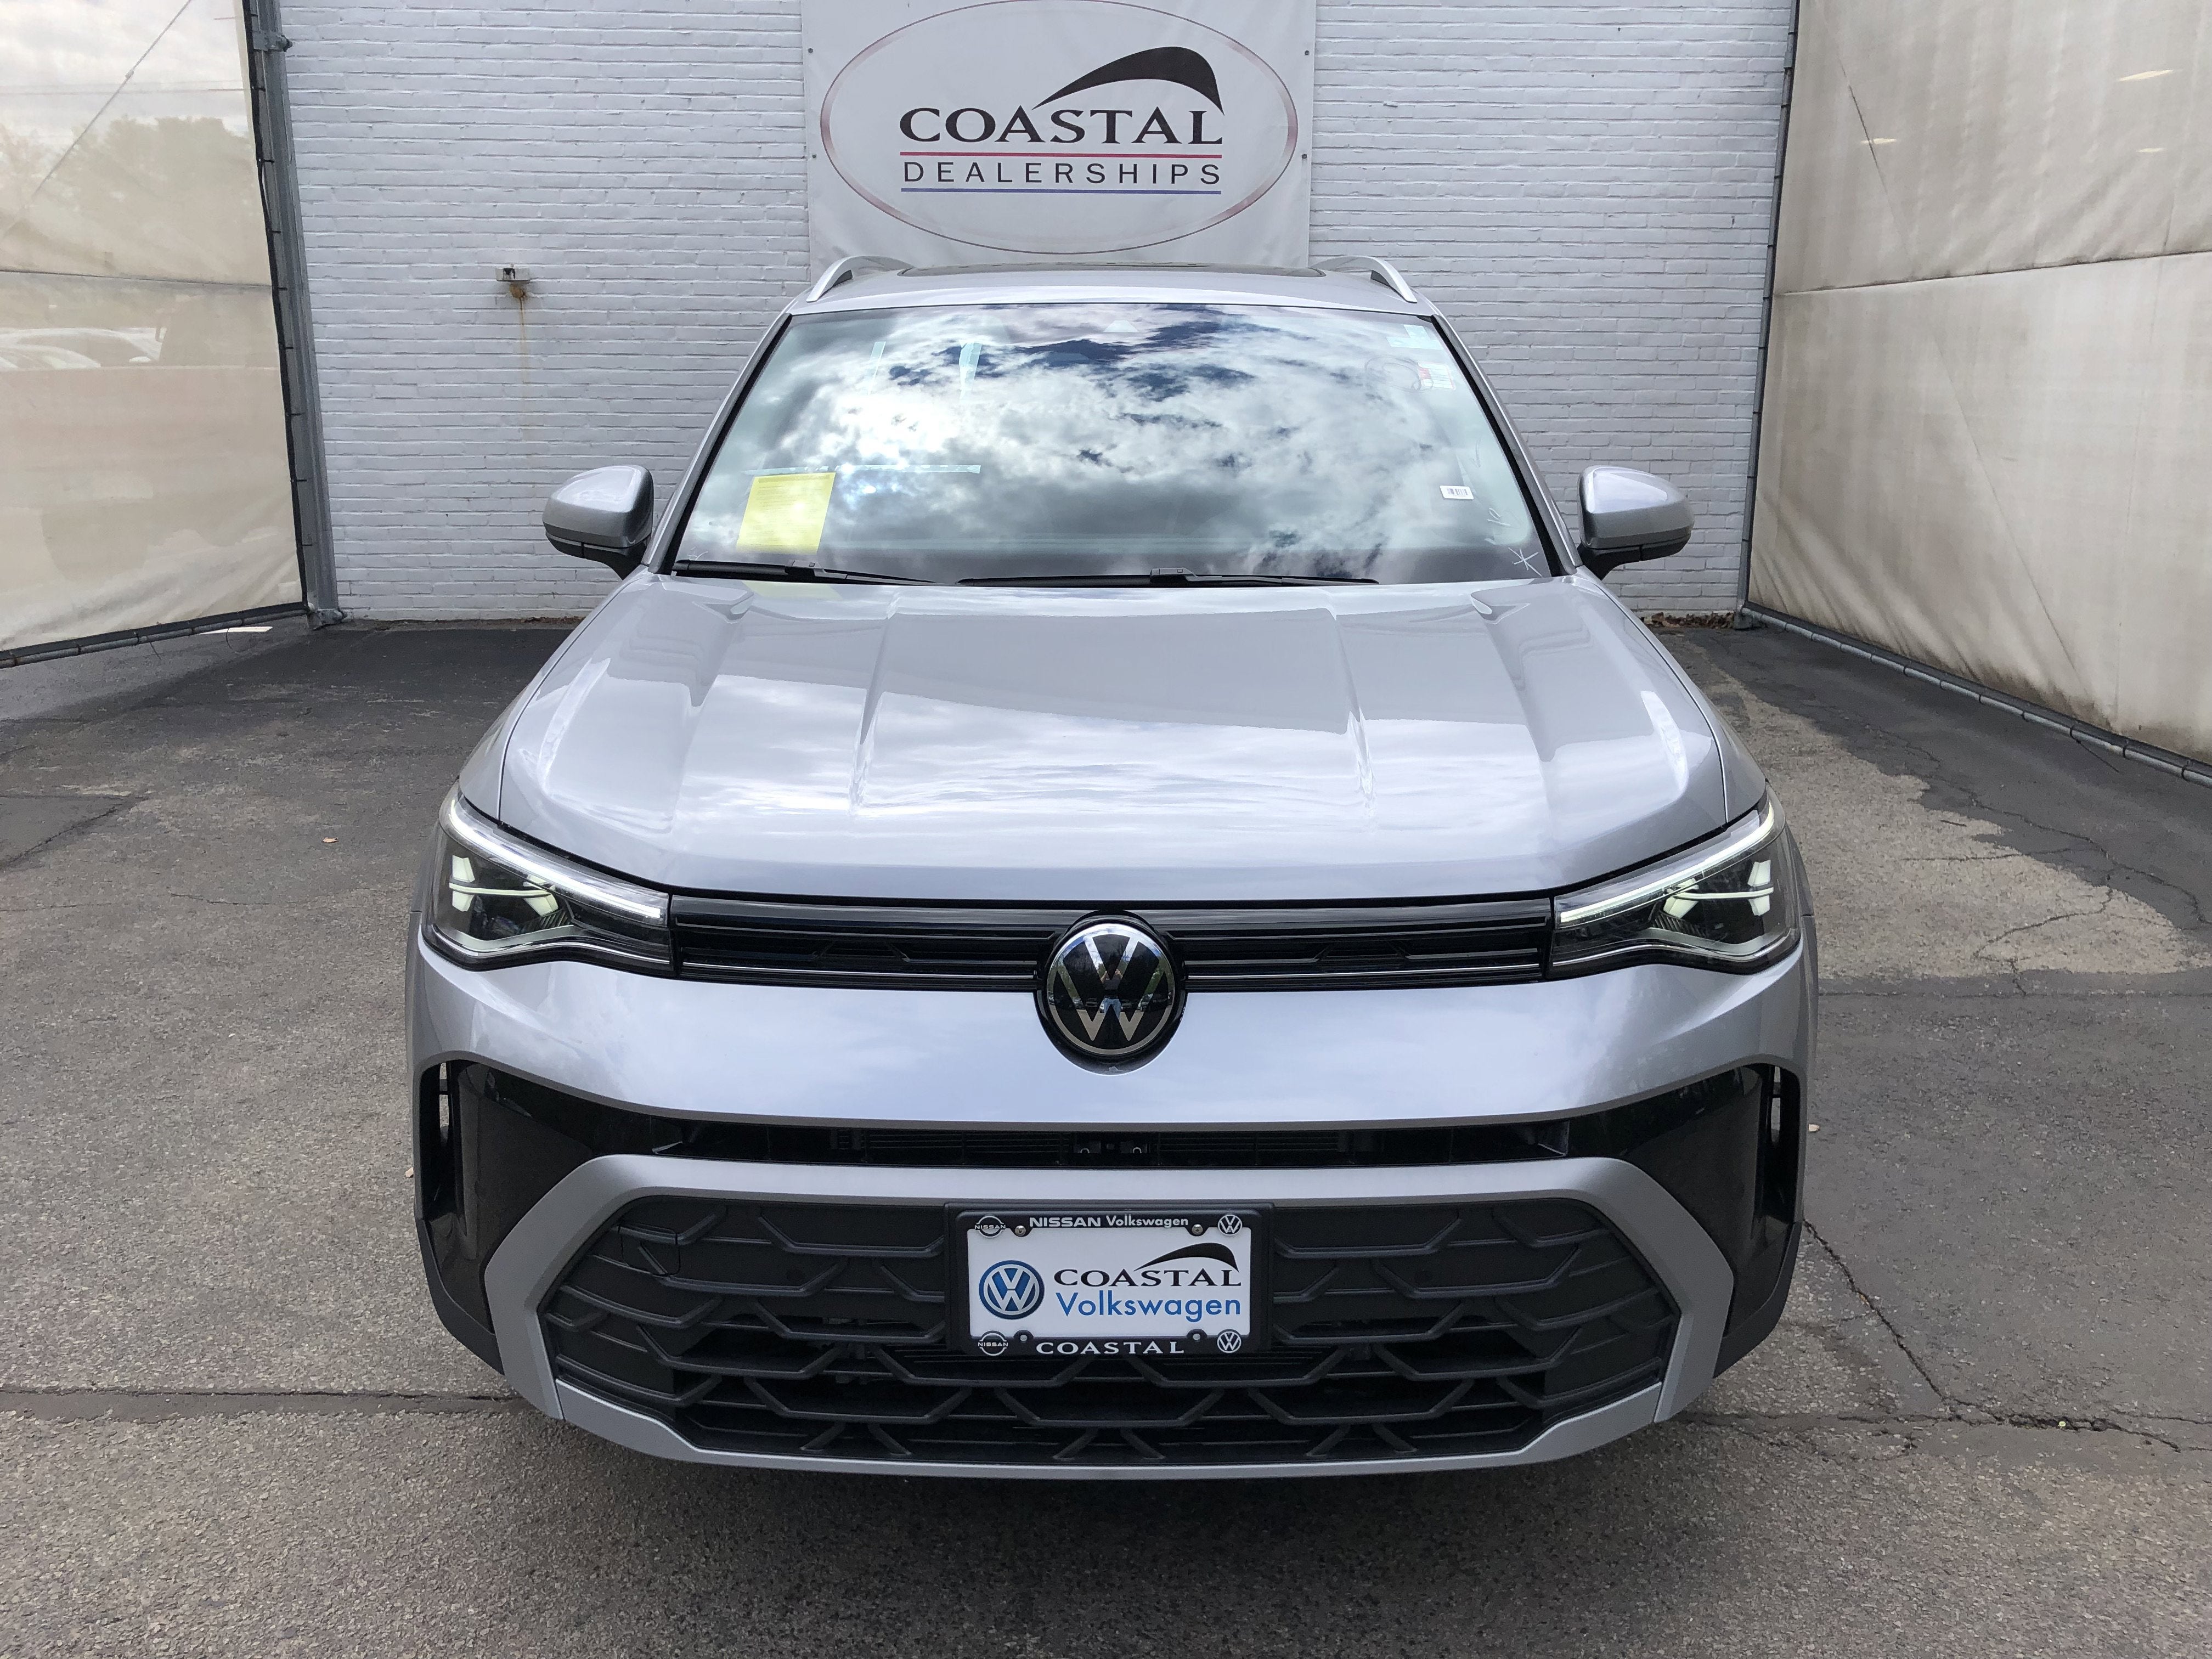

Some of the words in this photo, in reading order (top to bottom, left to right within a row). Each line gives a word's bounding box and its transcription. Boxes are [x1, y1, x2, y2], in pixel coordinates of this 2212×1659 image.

[899, 106, 1223, 145] COASTAL
[904, 161, 1220, 185] DEALERSHIPS
[1049, 927, 1173, 1052] VW
[1030, 1217, 1101, 1227] NISSAN
[1107, 1215, 1188, 1227] Volkswagen
[984, 1264, 1040, 1316] VW
[1053, 1268, 1242, 1287] COASTAL
[1056, 1290, 1241, 1322] Volkswagen
[1036, 1341, 1184, 1355] COASTAL
